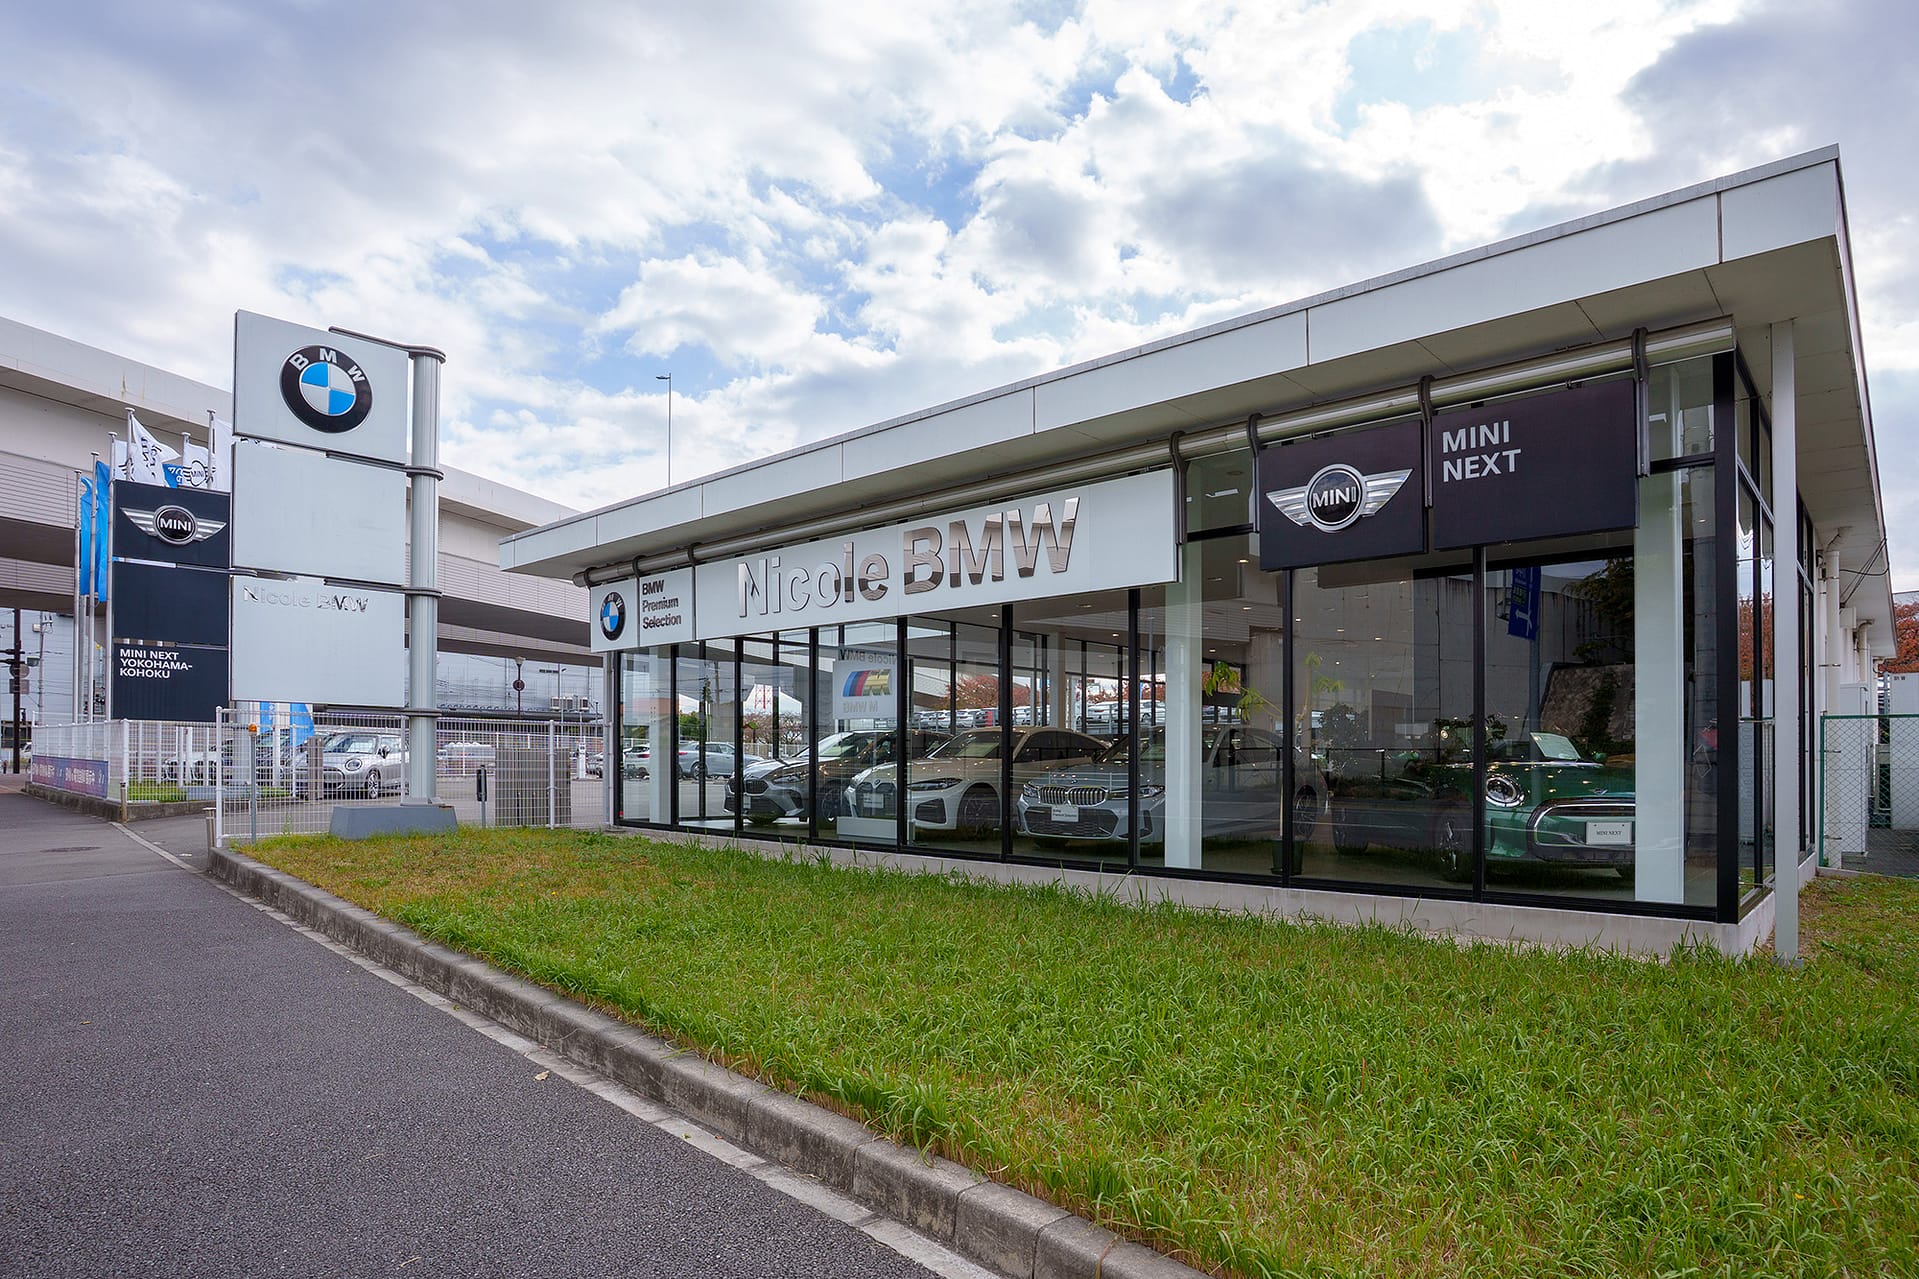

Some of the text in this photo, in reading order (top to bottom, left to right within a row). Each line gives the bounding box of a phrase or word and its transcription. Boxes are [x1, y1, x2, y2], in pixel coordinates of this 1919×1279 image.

[288, 347, 366, 382] BMW
[1442, 420, 1510, 453] MINI
[1443, 449, 1522, 483] NEXT
[1312, 486, 1357, 509] MINI
[160, 518, 192, 532] MINI
[738, 496, 1081, 617] Nicole BMW
[642, 580, 664, 595] BMW
[243, 585, 369, 612] Nicole BMW
[642, 596, 679, 612] Premium
[642, 613, 682, 629] Selection
[120, 648, 179, 660] MINI NEXT
[120, 658, 193, 671] YOKOHAMA-
[120, 668, 171, 679] KOHOKU
